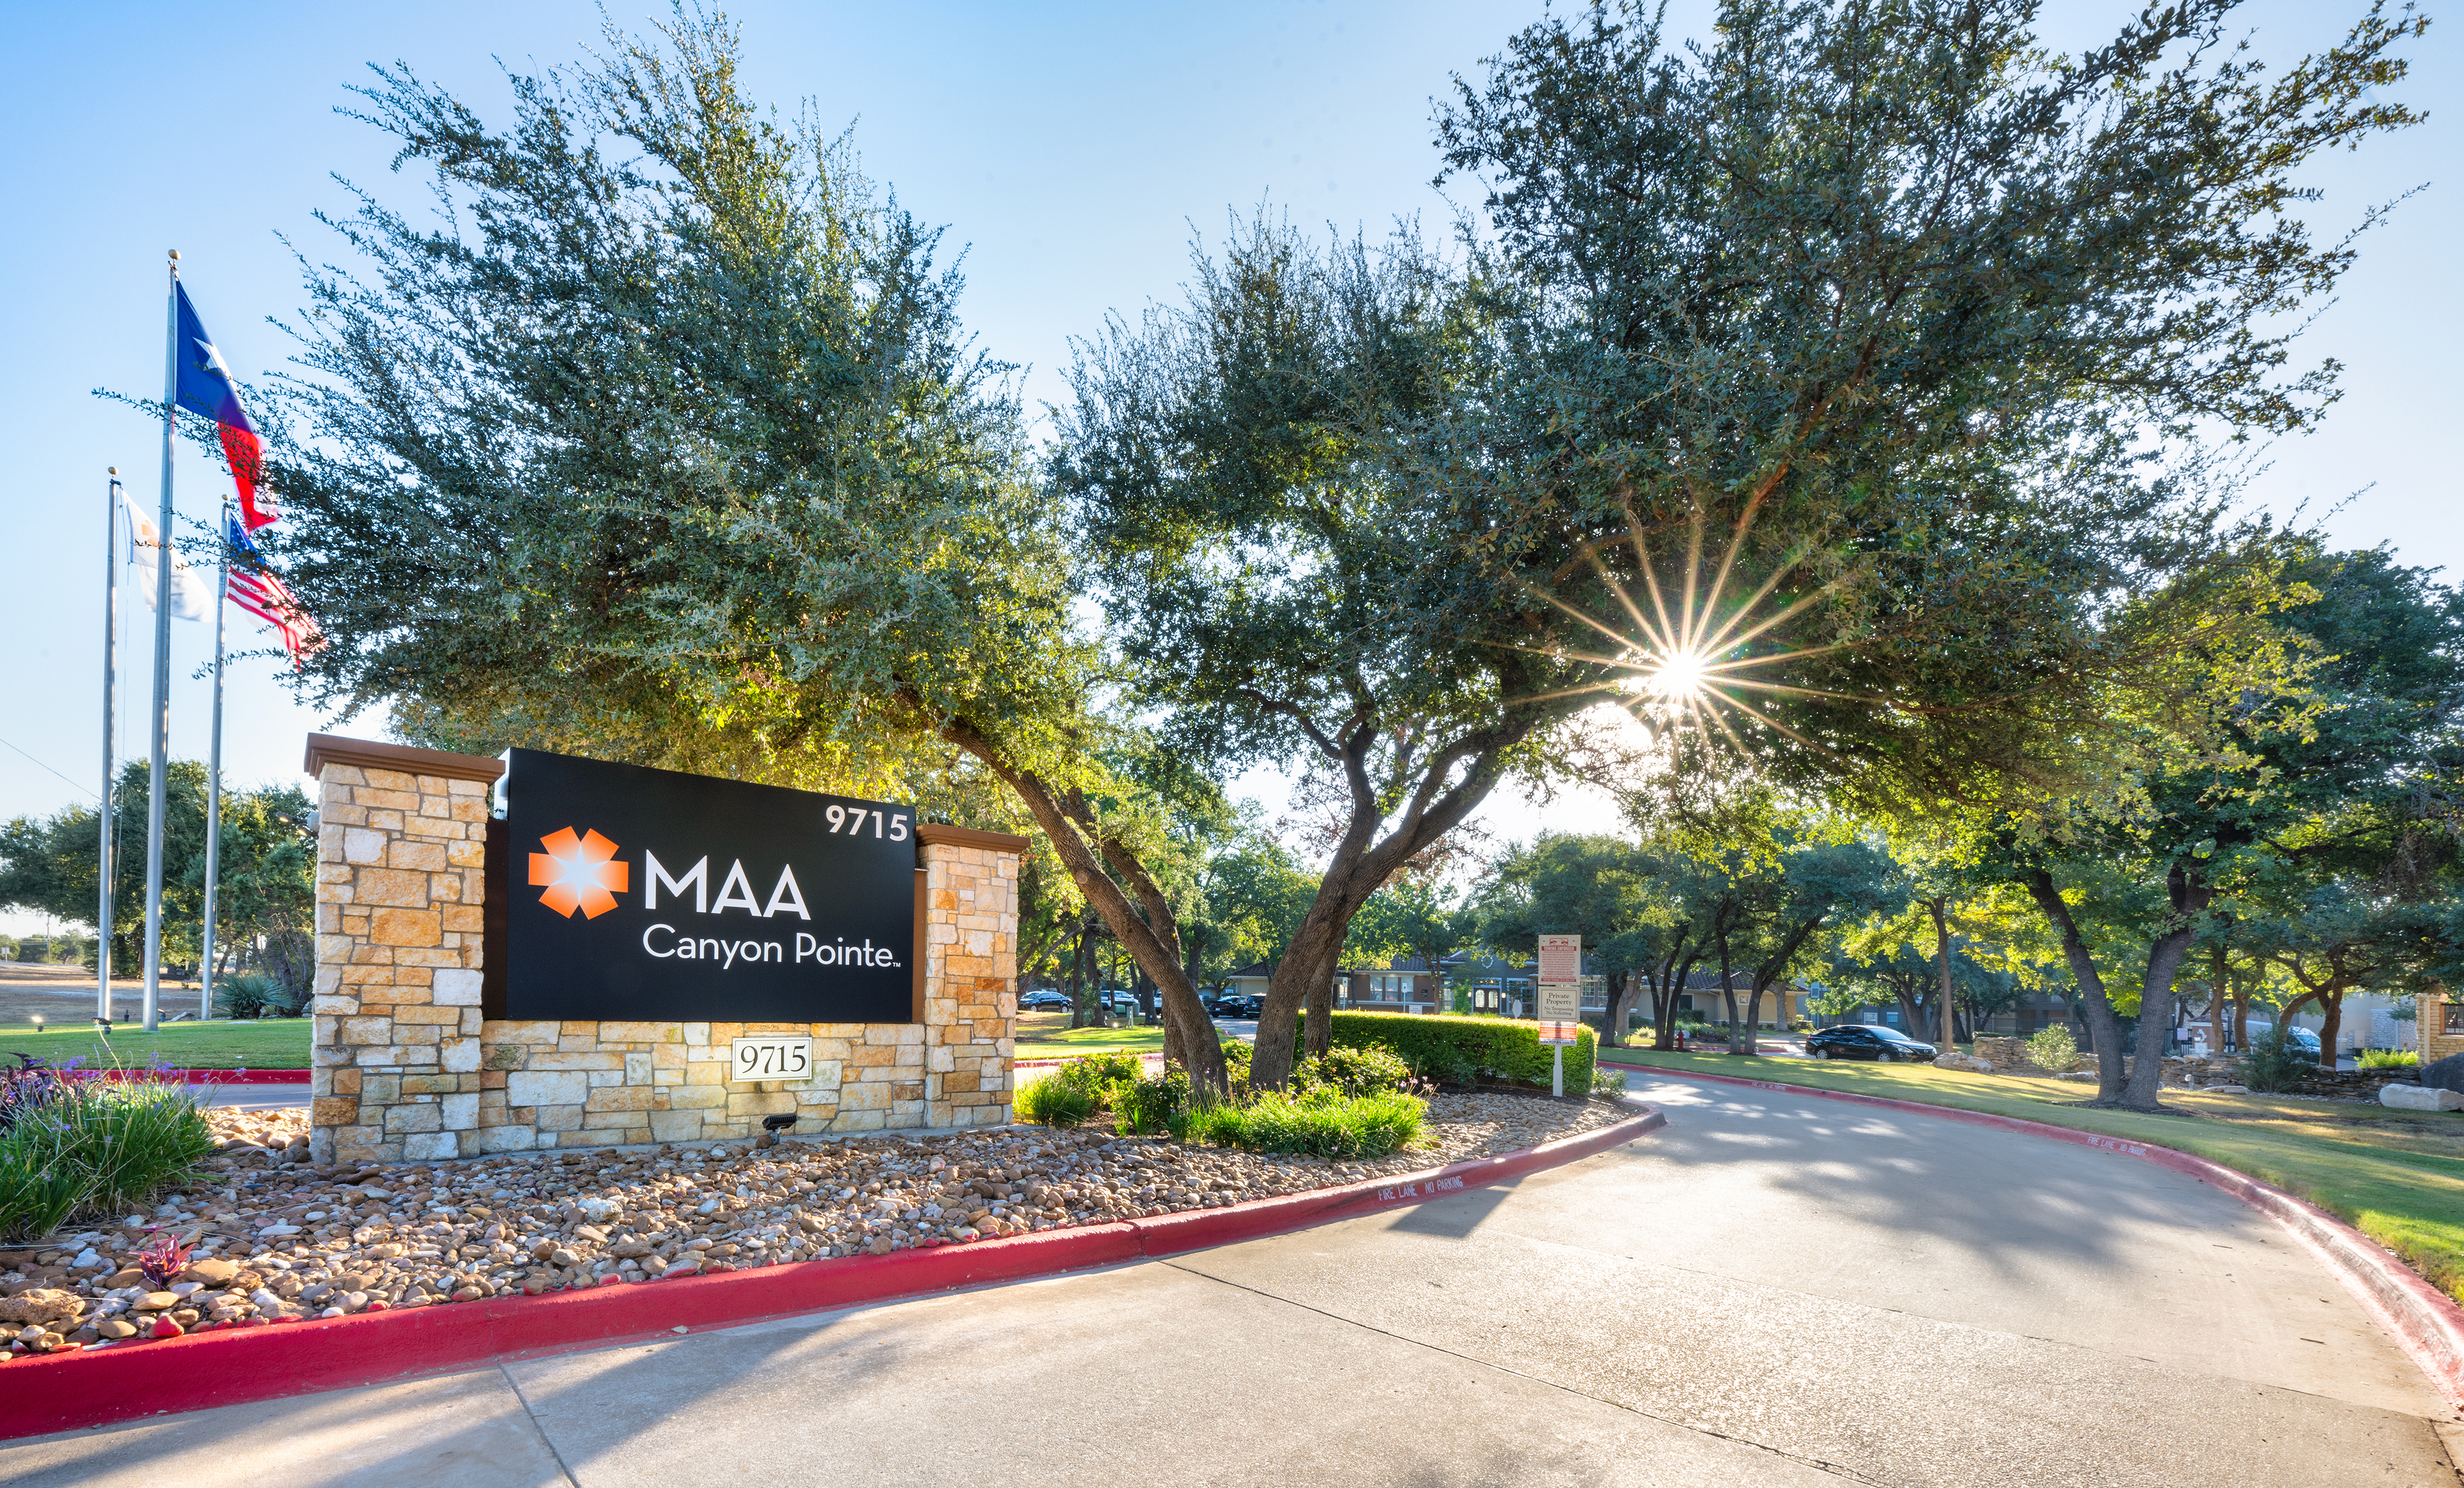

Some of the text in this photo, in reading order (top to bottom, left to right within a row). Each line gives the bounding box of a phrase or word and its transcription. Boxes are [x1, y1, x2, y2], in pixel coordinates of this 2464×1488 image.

[826, 805, 908, 842] 9715
[645, 849, 811, 920] MAA
[642, 923, 782, 970] Canyon
[740, 1045, 806, 1074] 9715
[2087, 1136, 2100, 1145] FIRE
[2100, 1140, 2116, 1149] LANE
[2128, 1145, 2146, 1156] PARKING
[1378, 1176, 1463, 1201] FIRE LANE NO PARKING
